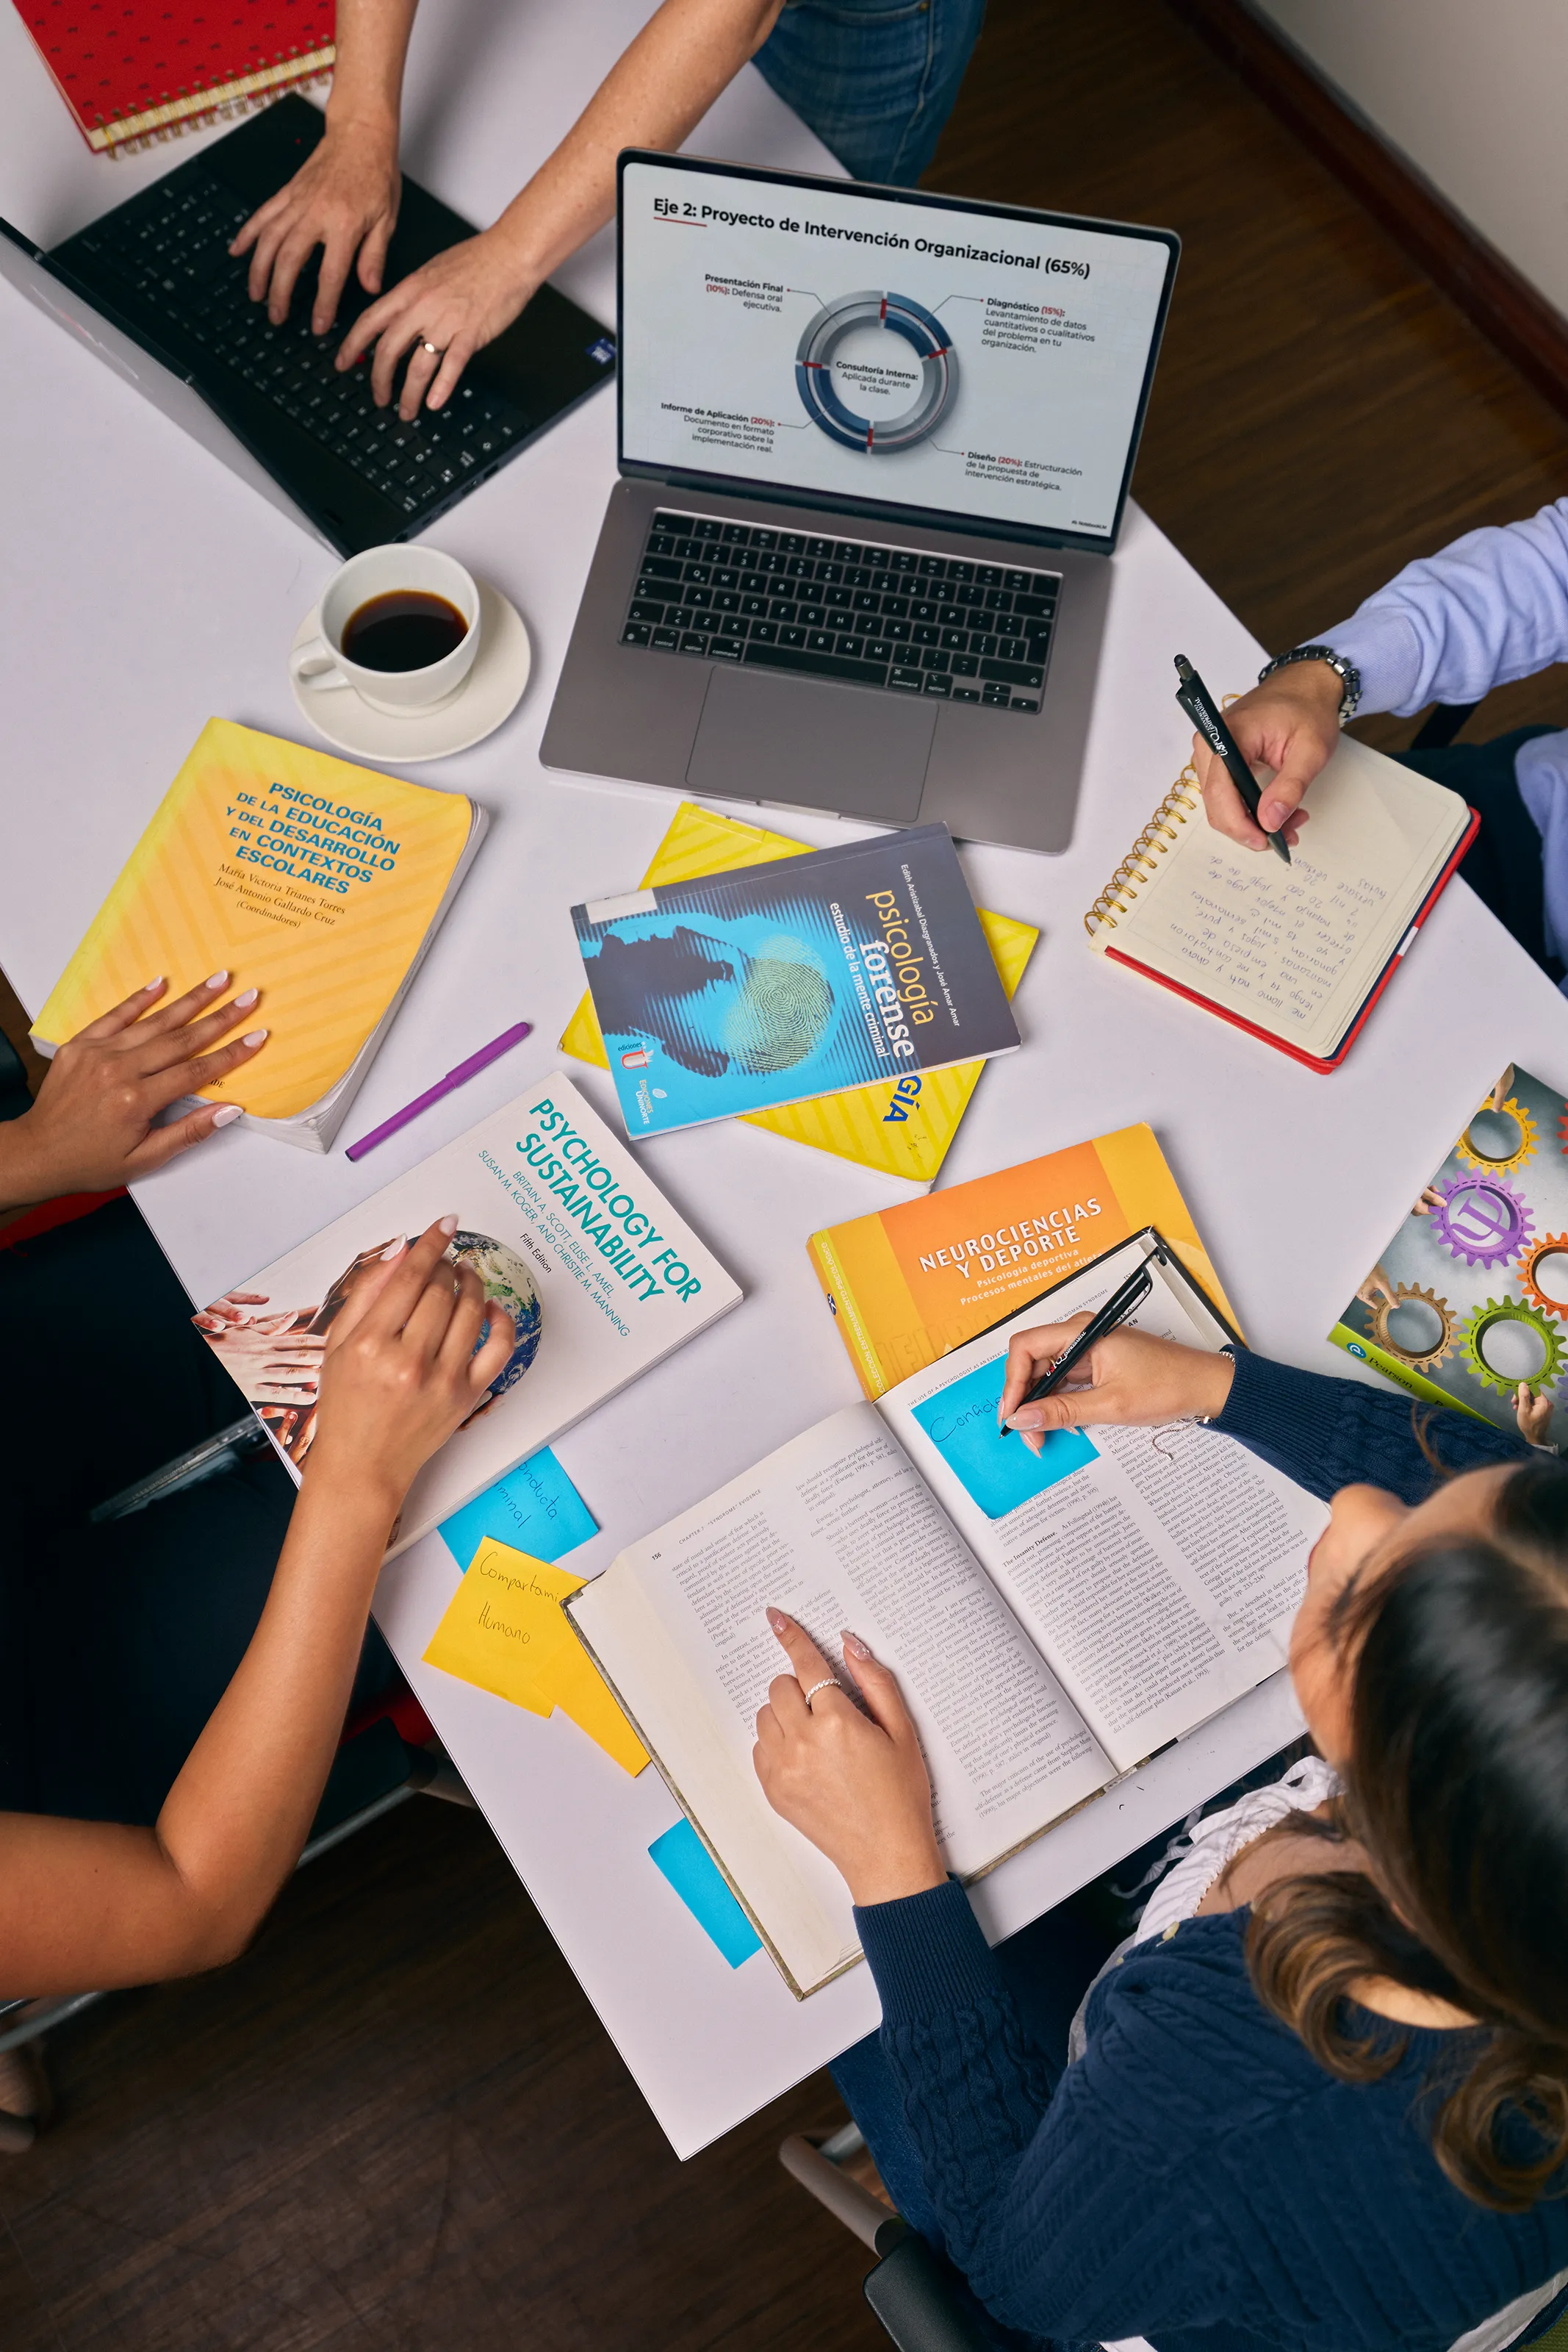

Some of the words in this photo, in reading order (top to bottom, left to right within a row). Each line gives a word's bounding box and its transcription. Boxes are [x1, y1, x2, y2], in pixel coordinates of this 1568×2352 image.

[654, 198, 678, 215] Eje
[683, 203, 697, 217] 2:
[702, 205, 774, 228] Proyecto
[779, 218, 799, 232] de
[805, 221, 909, 249] Intervención
[914, 238, 1040, 269] Organizacional
[1045, 257, 1090, 279] (65%)
[705, 273, 760, 289] Presentación
[762, 282, 783, 293] Final
[705, 284, 730, 295] (10%):
[732, 287, 765, 300] Defensa
[743, 300, 781, 312] ejecutiva.
[985, 308, 1049, 324] Levantamiento
[1050, 318, 1062, 326] de
[1062, 320, 1087, 330] datos
[987, 298, 1040, 312] Diagnóstico
[1040, 306, 1065, 318] (15%):
[981, 339, 1036, 353] organización.
[982, 328, 996, 336] del
[997, 331, 1037, 343] problema
[984, 319, 1037, 333] cuantitativos
[1047, 329, 1095, 342] cualitativos
[835, 361, 883, 375] Consultoría
[885, 369, 918, 380] Interna:
[841, 371, 877, 383] Aplicada
[878, 377, 910, 389] durante
[860, 383, 867, 391] la
[868, 385, 890, 395] clase.
[661, 403, 692, 413] Informe
[706, 409, 749, 422] Aplicación
[750, 417, 774, 427] (20%):
[683, 415, 730, 429] Documento
[743, 423, 774, 435] formato
[692, 434, 755, 450] implementación
[697, 427, 741, 439] corporativo
[743, 434, 765, 443] sobre
[965, 469, 1014, 482] intervención
[1015, 478, 1061, 490] estratégica.
[967, 451, 996, 462] Diseño
[998, 456, 1022, 467] (20%):
[1024, 460, 1082, 476] Estructuración
[978, 462, 985, 470] la
[987, 465, 1027, 476] propuesta
[712, 649, 738, 657] command
[892, 679, 918, 687] command
[236, 792, 256, 806] DE
[259, 800, 278, 814] LA
[285, 806, 400, 855] EDUCACIÓN
[269, 782, 381, 831] PSICOLOGÍA
[226, 806, 235, 816] Y
[238, 811, 263, 828] DEL
[268, 820, 395, 870] DESARROLLO
[229, 827, 251, 841] EN
[256, 834, 373, 883] CONTEXTOS
[235, 845, 349, 894] ESCOLARES
[213, 877, 234, 889] José
[235, 884, 271, 903] Antonio
[273, 897, 312, 917] Gallardo
[314, 911, 335, 925] Cruz
[218, 864, 245, 879] María
[249, 873, 281, 892] Victoria
[285, 886, 314, 903] Trianes
[319, 897, 345, 914] Torres
[236, 900, 301, 928] (Coordinadores)
[830, 903, 850, 944] estudio
[843, 945, 856, 960] de
[865, 890, 938, 1025] psicología
[901, 864, 912, 882] Edith
[907, 883, 924, 917] Aristizabal
[918, 918, 938, 964] Diazgranados
[936, 971, 947, 986] José
[942, 988, 952, 1005] Amar
[949, 1008, 960, 1026] Amar
[848, 961, 860, 972] la
[852, 974, 871, 1010] mente
[859, 939, 914, 1058] forense
[618, 1042, 642, 1051] ediciones
[864, 1012, 890, 1057] criminal
[516, 1133, 664, 1301] SUSTAINABILITY
[528, 1098, 663, 1248] PSYCHOLOGY
[651, 1248, 701, 1303] FOR
[478, 1150, 506, 1180] SUSAN
[500, 1179, 511, 1191] M.
[510, 1190, 538, 1224] KOGER,
[535, 1224, 555, 1244] AND
[553, 1244, 585, 1280] CHRISTIE
[580, 1279, 591, 1292] M.
[589, 1291, 630, 1336] MANNING
[512, 1171, 541, 1202] BRITAIN
[536, 1203, 546, 1213] A.
[545, 1212, 572, 1243] SCOTT,
[568, 1241, 589, 1264] ELISE
[585, 1262, 593, 1272] L.
[591, 1272, 614, 1298] AMEL,
[919, 1198, 1101, 1272] NEUROCIENCIAS
[955, 1261, 969, 1278] Y
[979, 1225, 1080, 1272] DEPORTE
[519, 1233, 534, 1250] Fifth
[531, 1248, 551, 1273] Edition
[977, 1266, 1028, 1288] Psicología
[1030, 1249, 1079, 1269] deportiva
[960, 1286, 1005, 1305] Procesos
[1007, 1269, 1053, 1289] mentales
[1055, 1262, 1071, 1273] del
[840, 1290, 868, 1349] ENTRENAMIENTO
[1063, 1304, 1082, 1317] WOMAN
[1082, 1288, 1107, 1305] SYNDROME
[938, 1367, 972, 1388] PSYCHOLOGIST
[986, 1351, 1002, 1361] EXPERT
[1369, 1358, 1412, 1388] Pearson
[519, 1463, 557, 1520] onducta
[678, 1529, 700, 1544] CHAPTER
[738, 1489, 760, 1505] EVIDENCE
[652, 1552, 661, 1560] 156
[1013, 1544, 1034, 1560] Insanity
[1035, 1532, 1057, 1546] Defense.
[480, 1551, 559, 1602] Compartami
[478, 1601, 530, 1643] Humano
